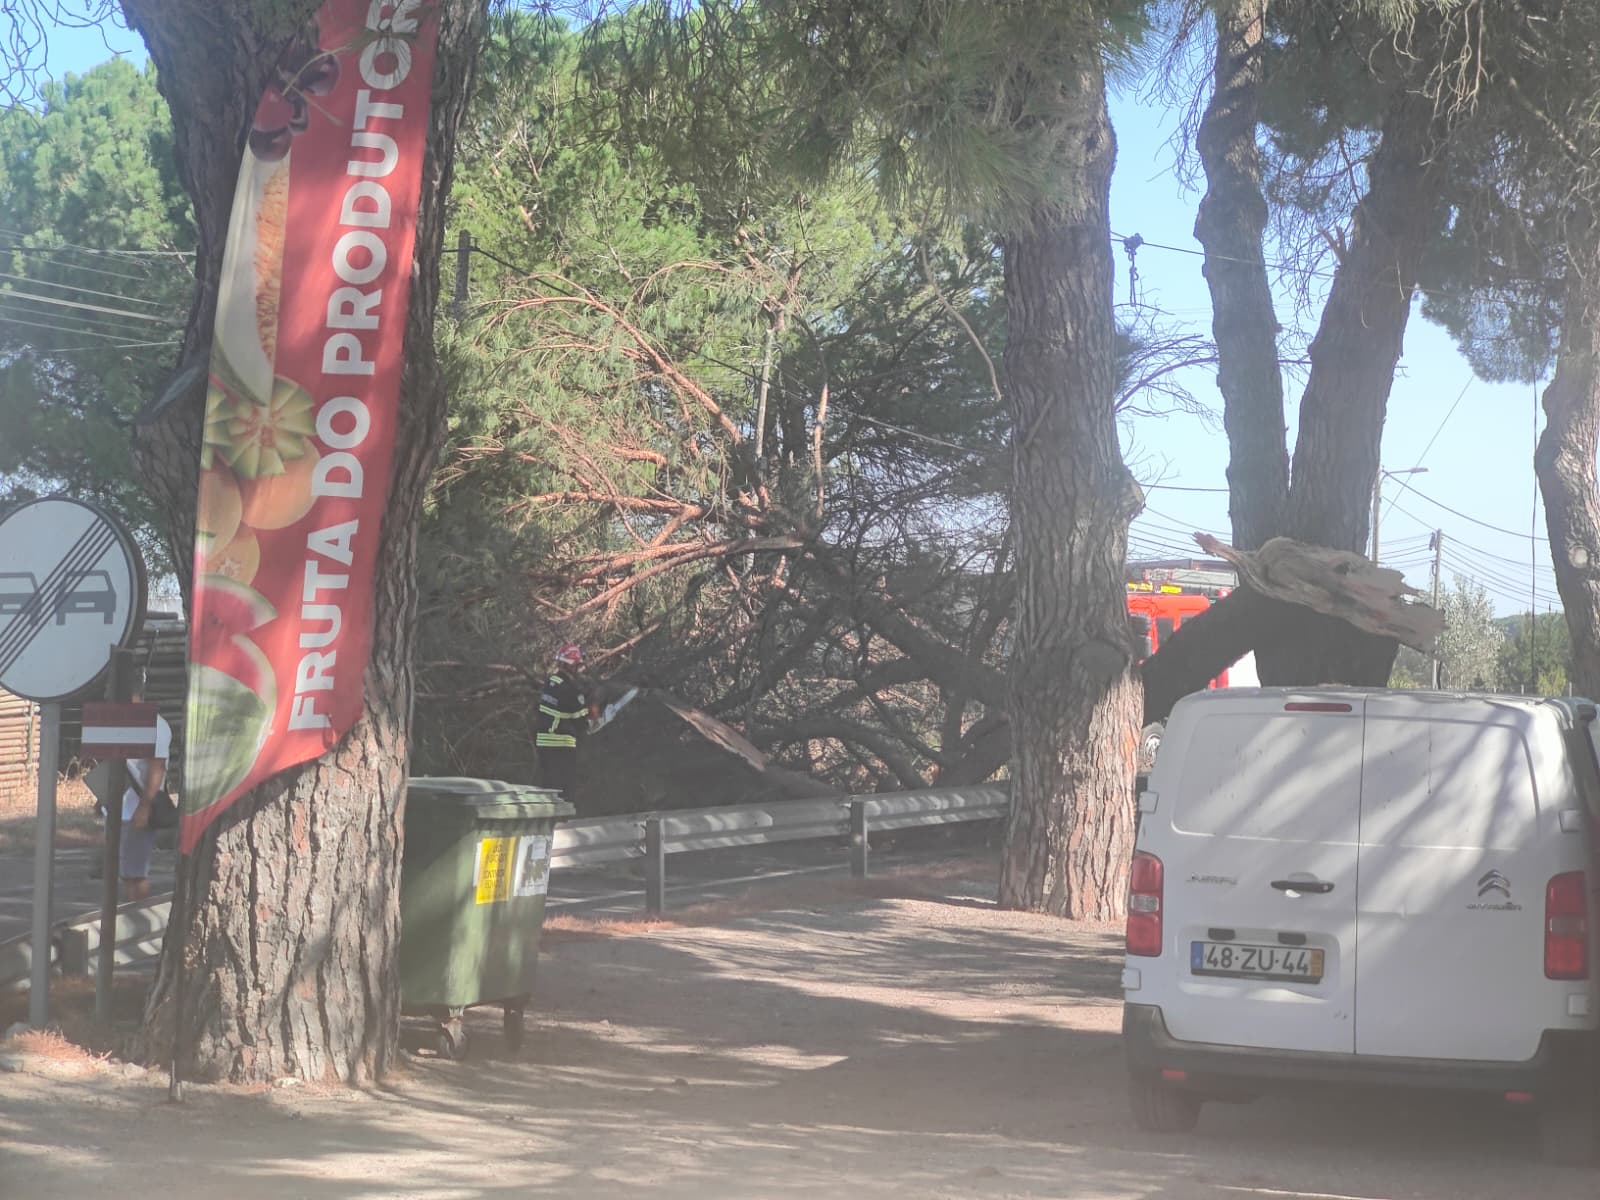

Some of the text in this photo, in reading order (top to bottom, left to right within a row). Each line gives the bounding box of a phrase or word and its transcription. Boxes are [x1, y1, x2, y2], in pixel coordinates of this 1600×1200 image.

[287, 0, 421, 731] FRUTA DO PRODUTOR
